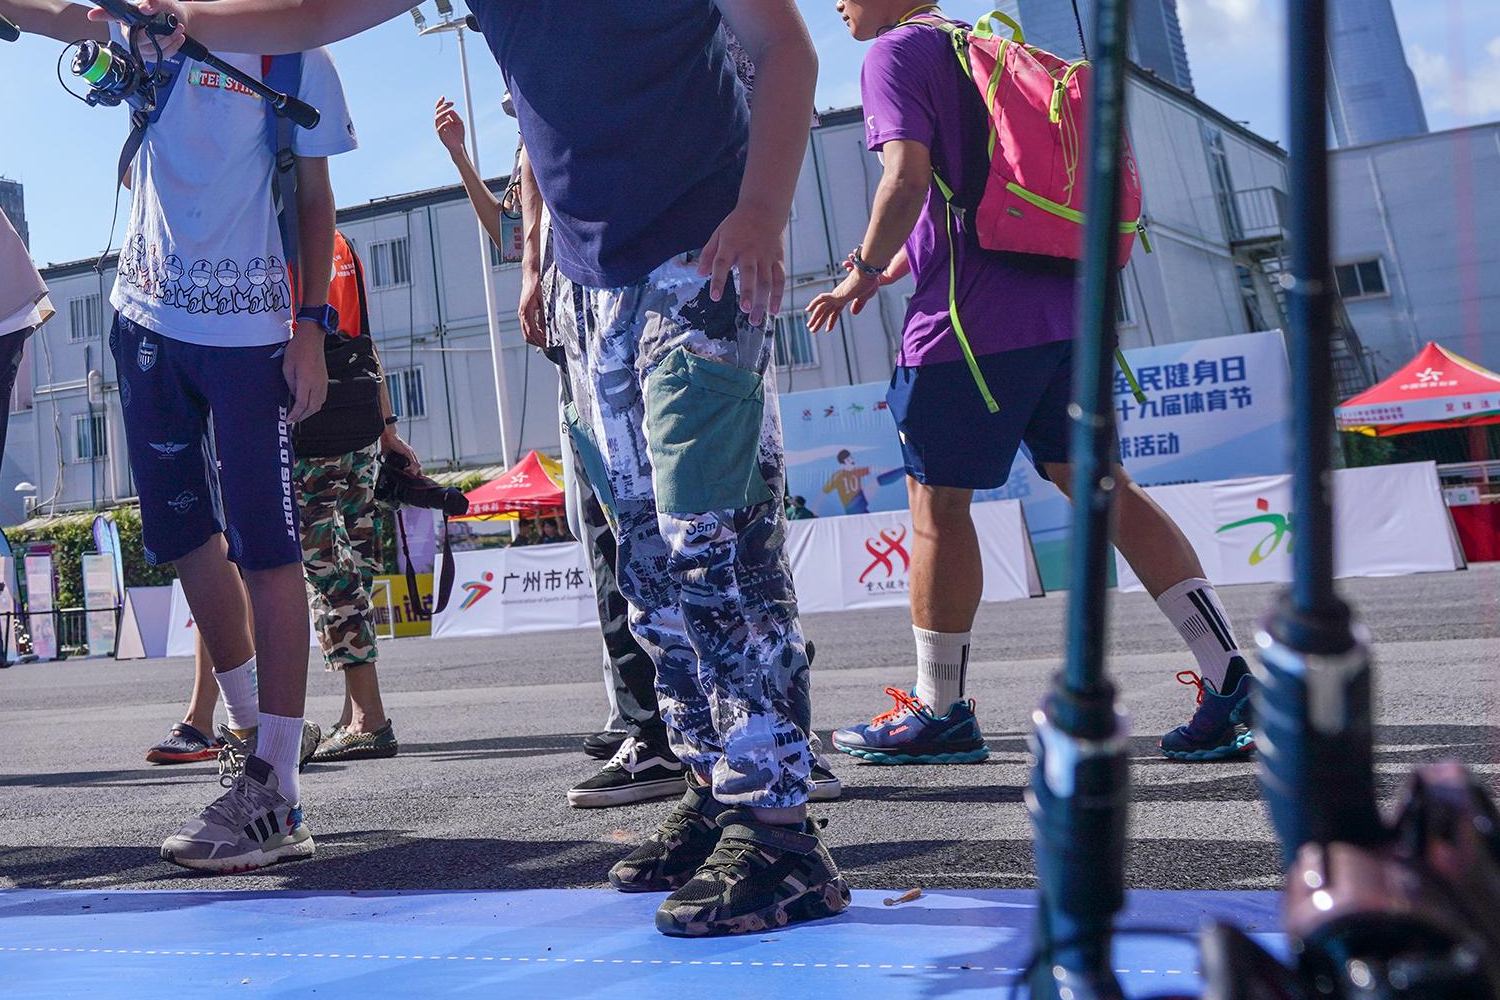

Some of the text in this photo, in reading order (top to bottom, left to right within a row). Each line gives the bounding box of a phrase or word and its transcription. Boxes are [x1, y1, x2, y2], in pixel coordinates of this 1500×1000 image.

[1116, 386, 1253, 421] 十九届体育节
[843, 474, 859, 494] 10
[280, 466, 297, 543] SPORT
